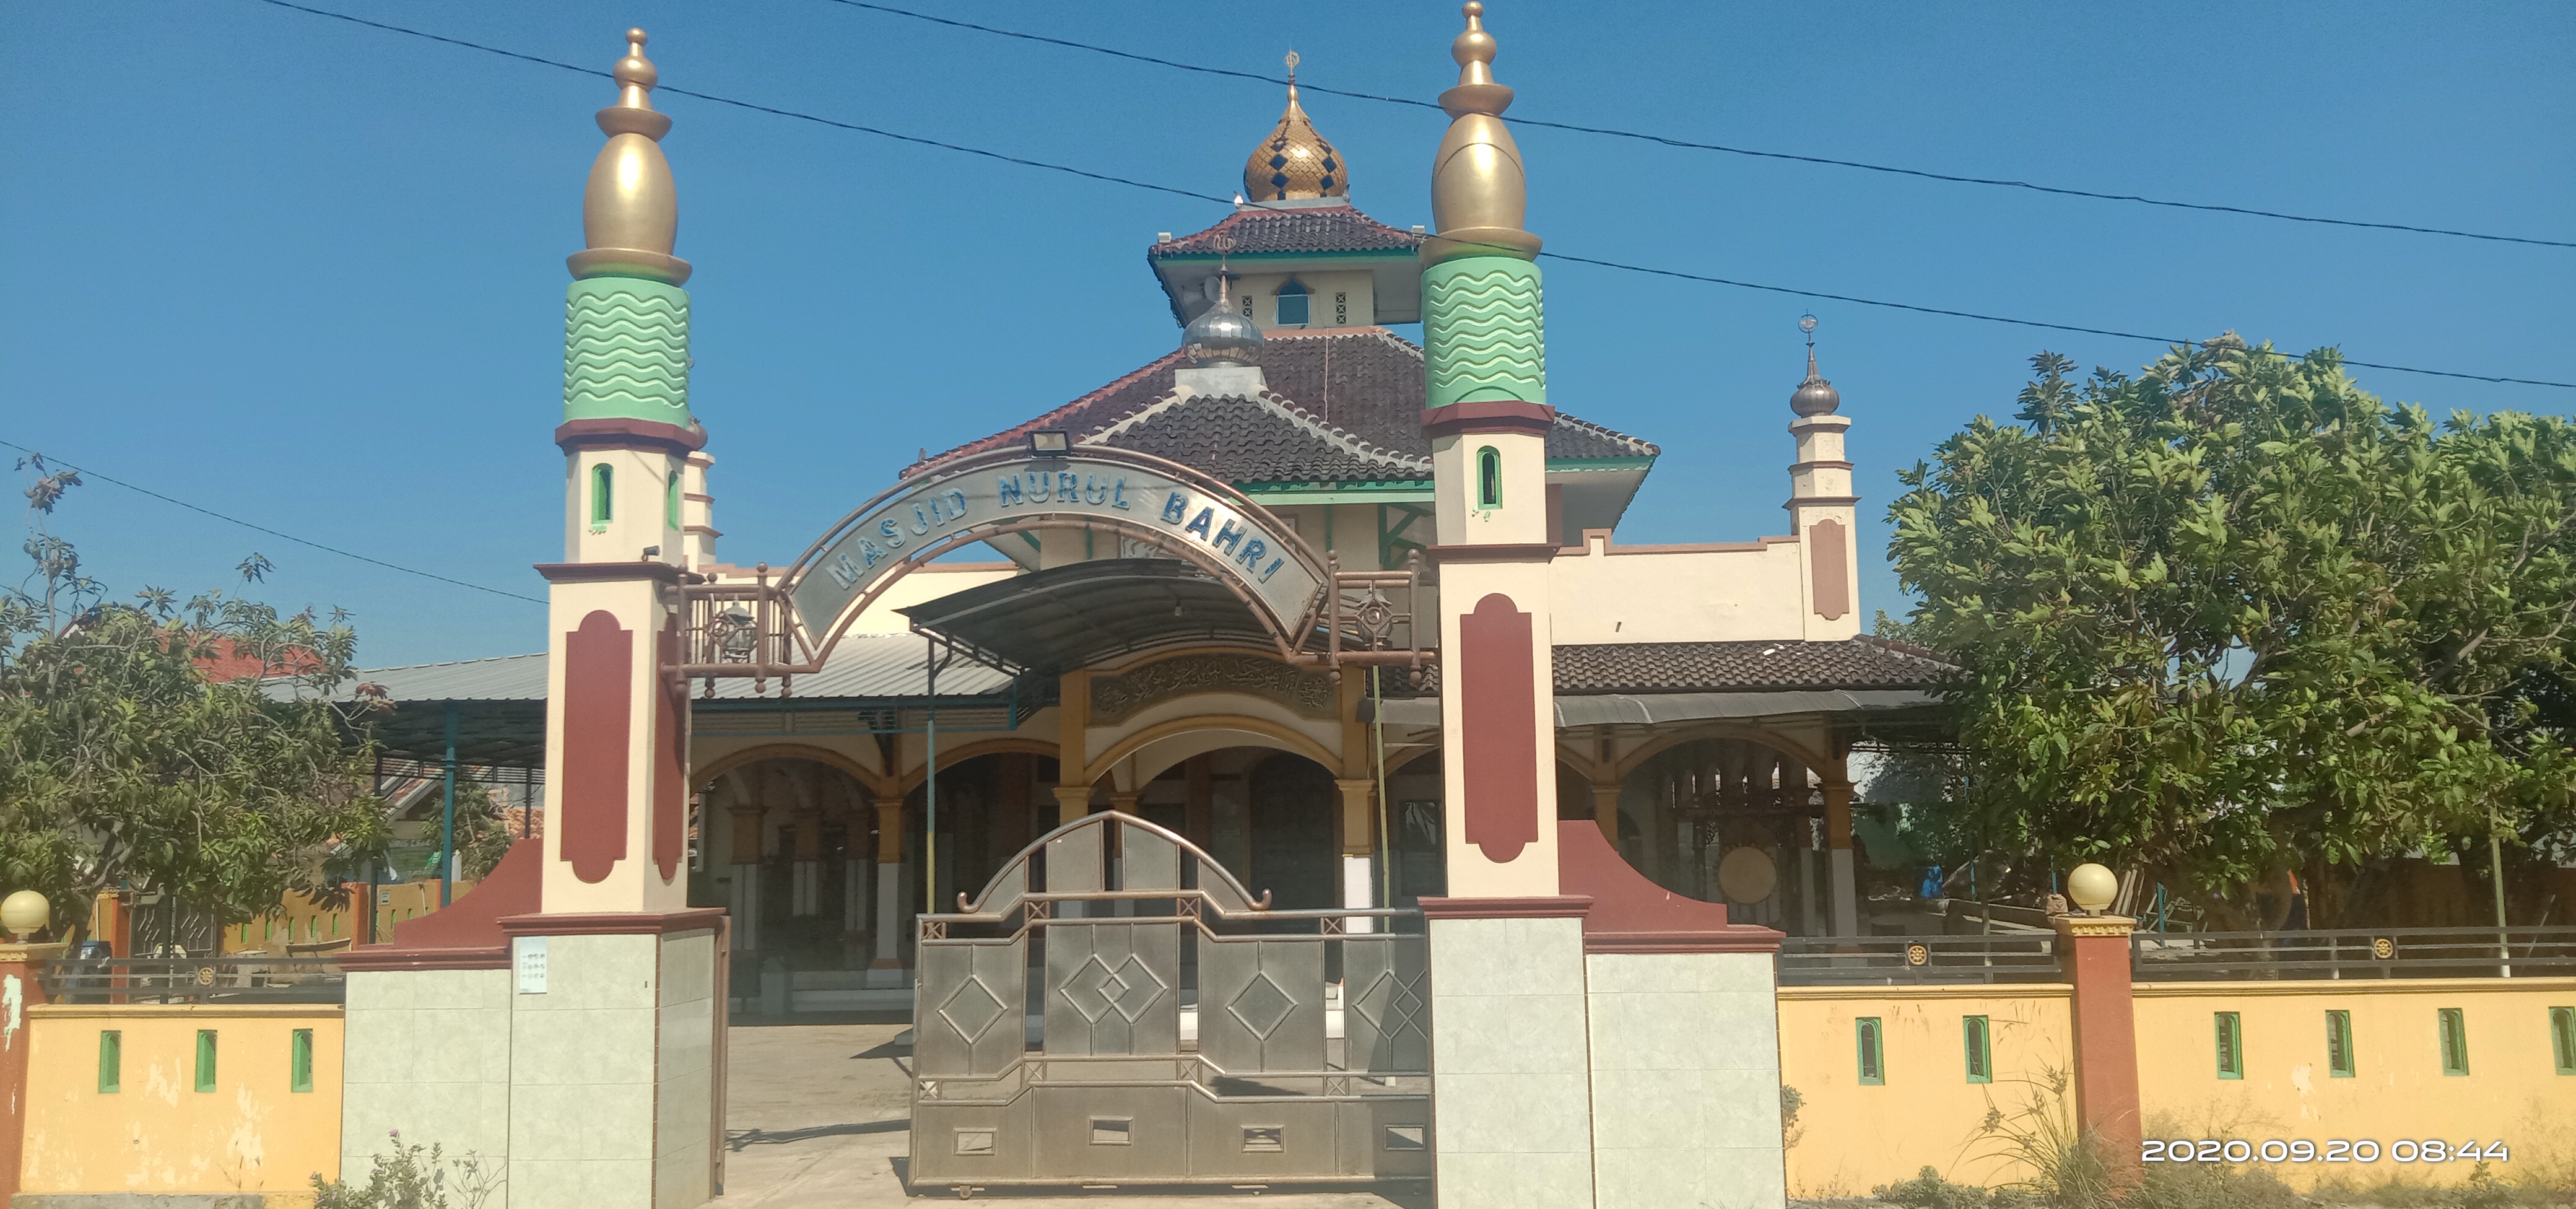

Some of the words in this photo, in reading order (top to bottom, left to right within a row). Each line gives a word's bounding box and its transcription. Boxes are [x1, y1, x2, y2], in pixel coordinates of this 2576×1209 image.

[825, 488, 967, 590] MASJID
[998, 471, 1131, 511] NURUL
[1160, 491, 1285, 585] BAHRI
